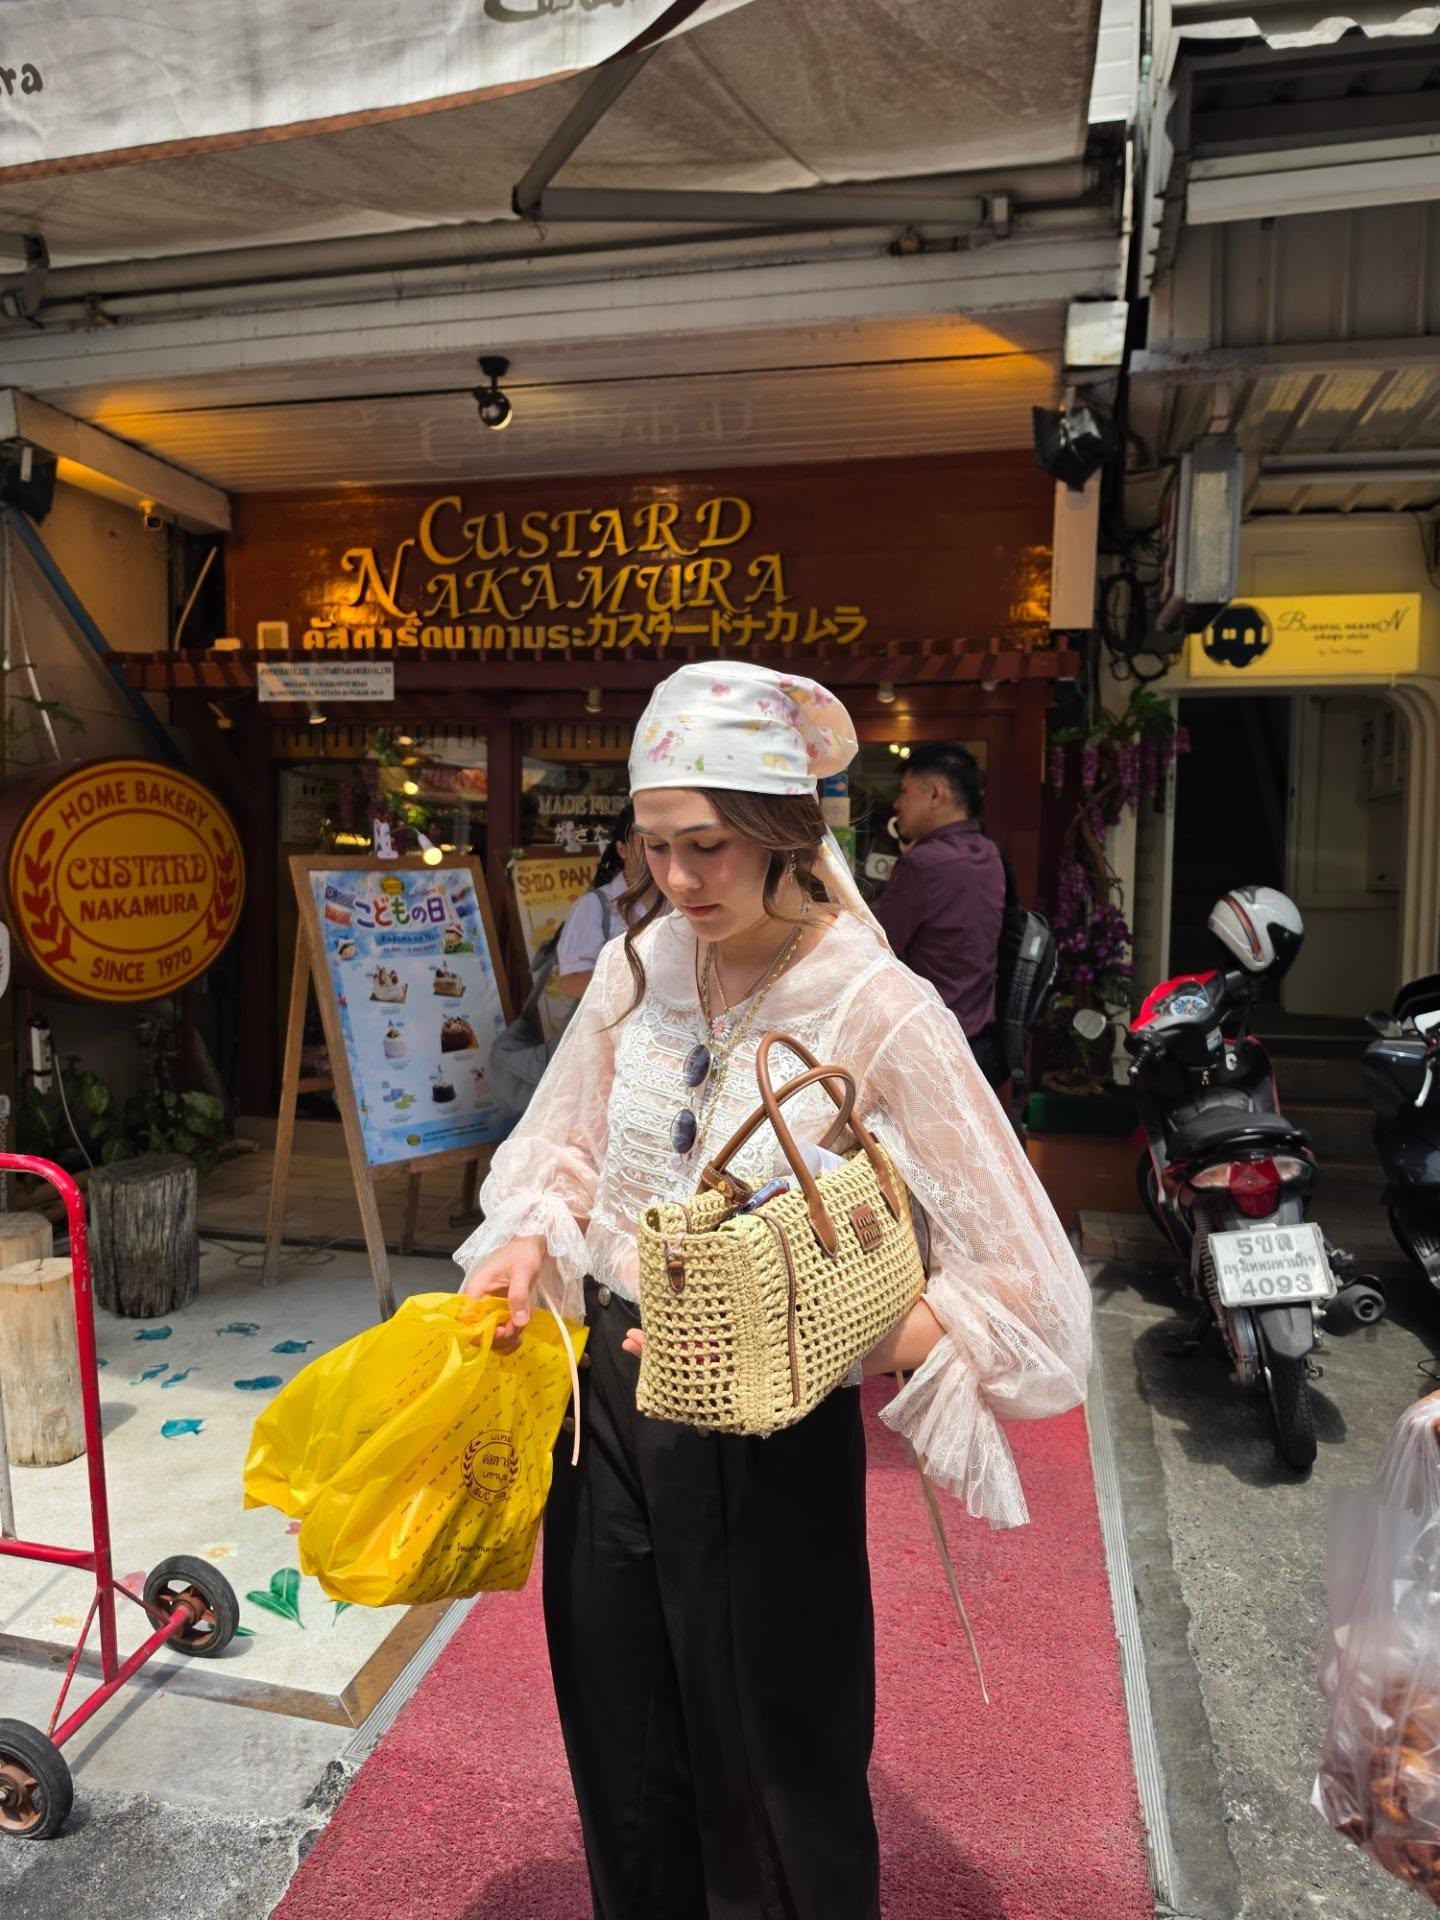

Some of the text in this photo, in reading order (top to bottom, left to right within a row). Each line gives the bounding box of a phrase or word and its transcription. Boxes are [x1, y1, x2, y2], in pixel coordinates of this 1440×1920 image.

[420, 496, 754, 565] CUSTARD
[341, 539, 794, 620] NAKAMURA
[586, 605, 868, 648] カスタードナカムラ
[59, 780, 208, 831] HOME BAKERY
[66, 853, 207, 891] CUSTARD
[558, 865, 592, 889] PAN
[80, 892, 200, 922] NAKAMURA
[354, 895, 446, 928] こどもの日
[90, 945, 192, 983] SINCE 1970
[1242, 1273, 1314, 1298] 4093
